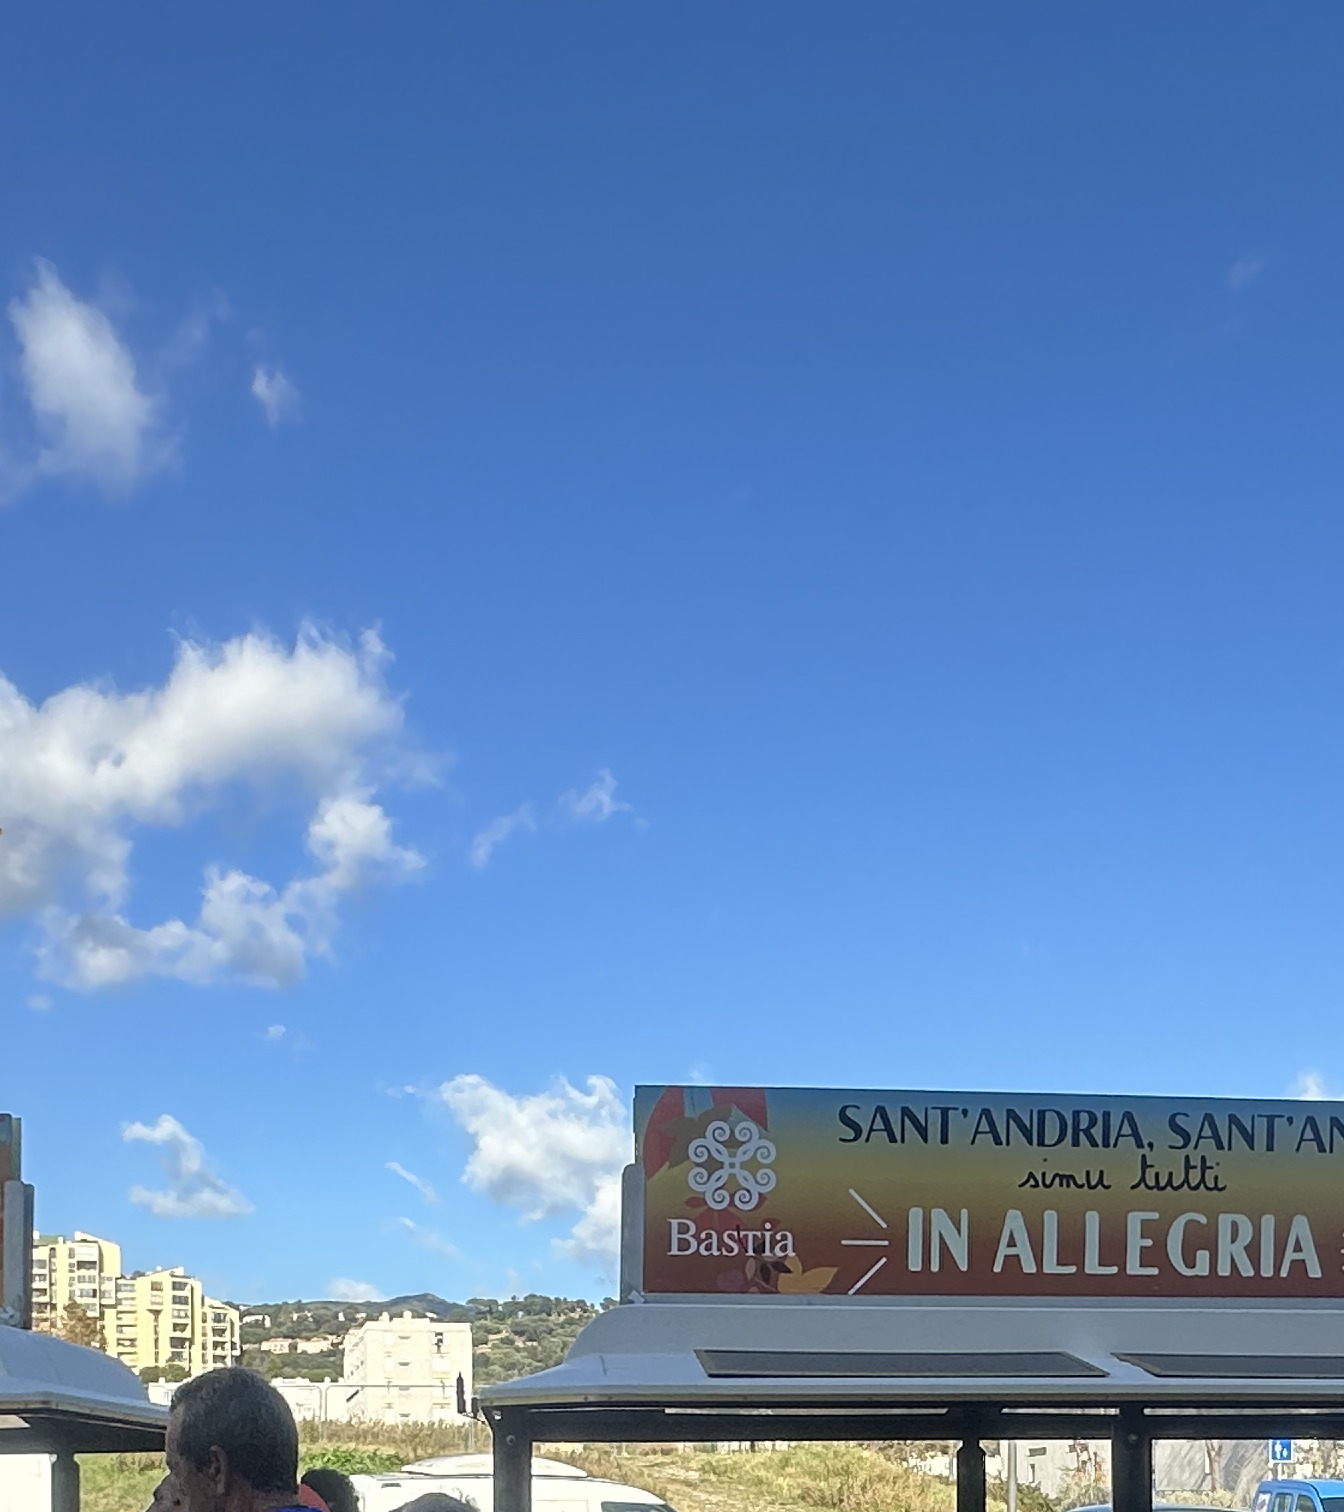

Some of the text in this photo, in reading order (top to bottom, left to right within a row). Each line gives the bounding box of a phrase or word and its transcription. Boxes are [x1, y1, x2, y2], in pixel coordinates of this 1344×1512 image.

[837, 1103, 1154, 1152] SANT'ANDRIA,
[1018, 1154, 1228, 1192] simu tutti
[666, 1217, 797, 1258] Bastia
[907, 1206, 1323, 1278] IN ALLEGRIA
